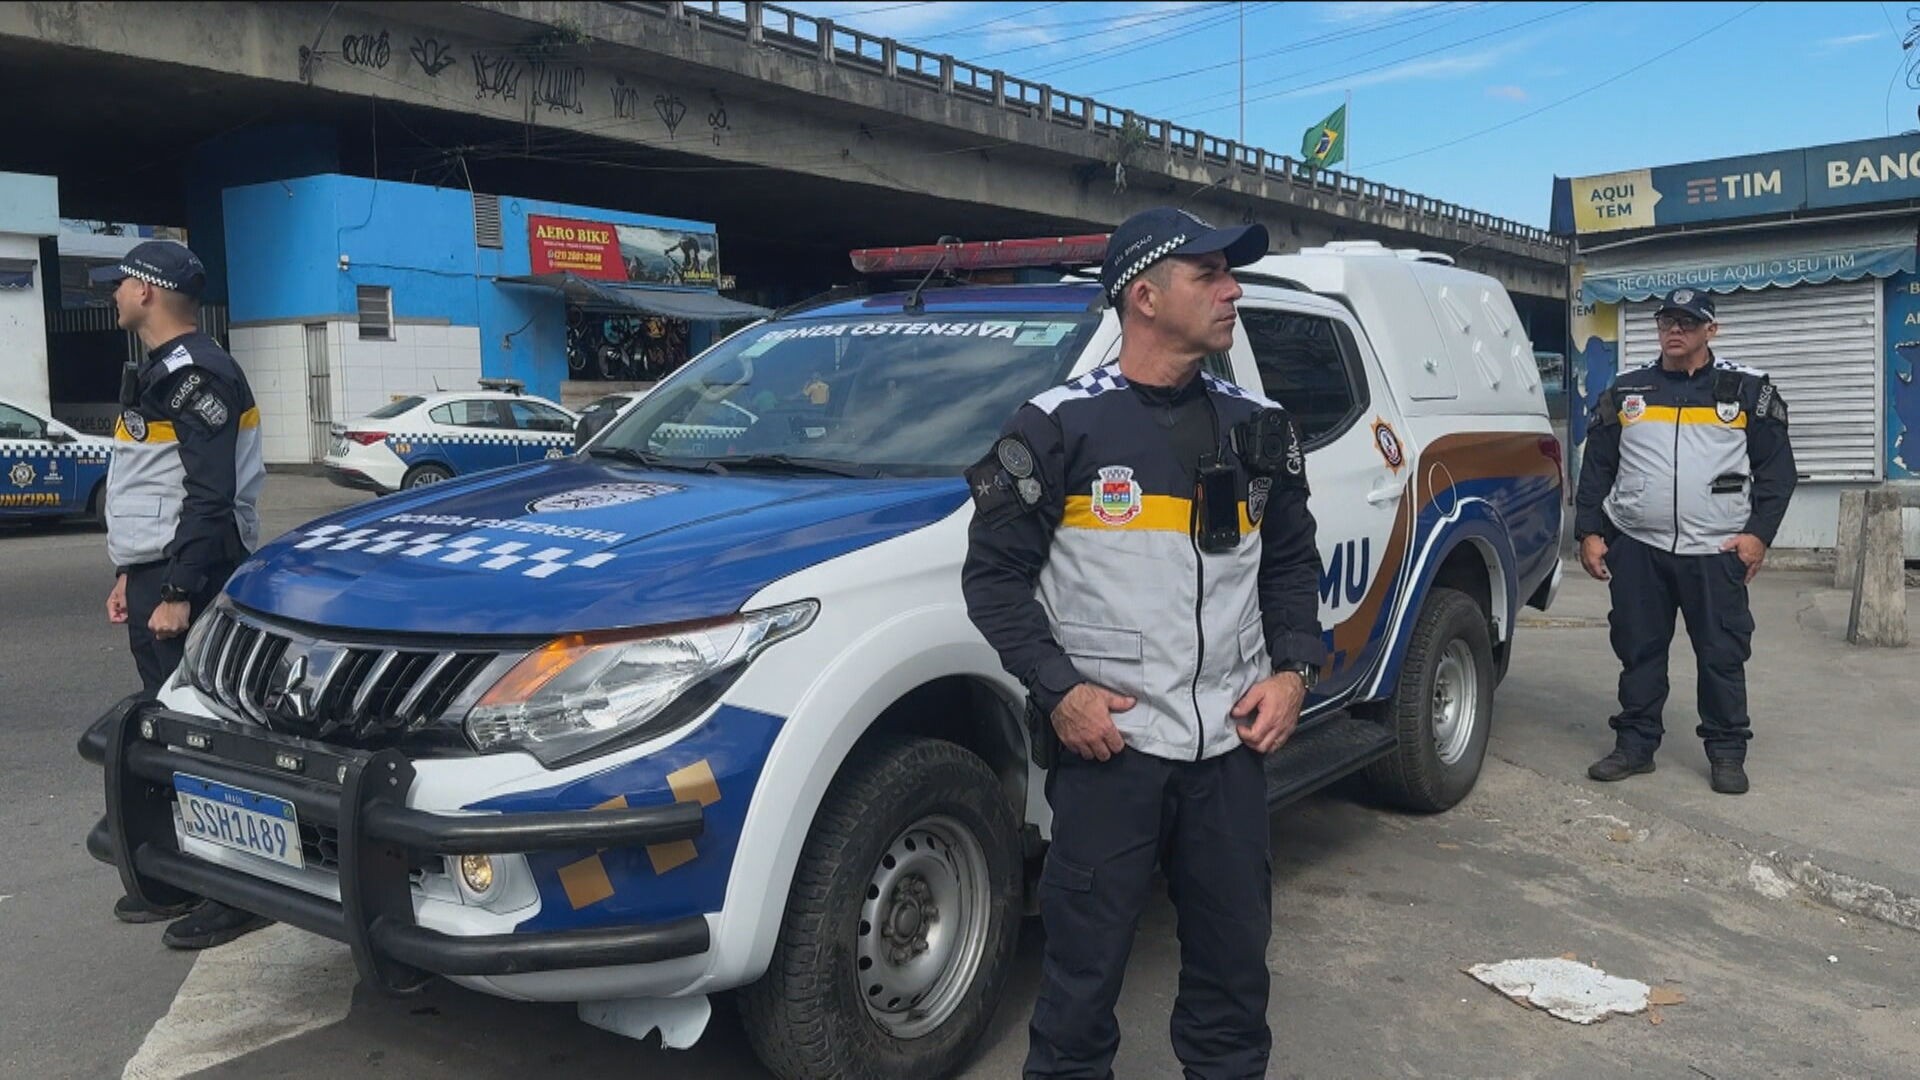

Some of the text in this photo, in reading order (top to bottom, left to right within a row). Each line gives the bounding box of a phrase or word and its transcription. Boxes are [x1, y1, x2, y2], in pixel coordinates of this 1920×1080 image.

[1590, 184, 1634, 202] AQUI
[1722, 169, 1781, 200] TIM
[1595, 203, 1632, 218] TEM
[536, 224, 610, 244] AERO BIKE
[1617, 254, 1855, 291] RECARREGUE AQUI O SEU TIM
[757, 322, 1018, 342] RONDA OSTENSIVA
[190, 799, 287, 857] SSH1A89
